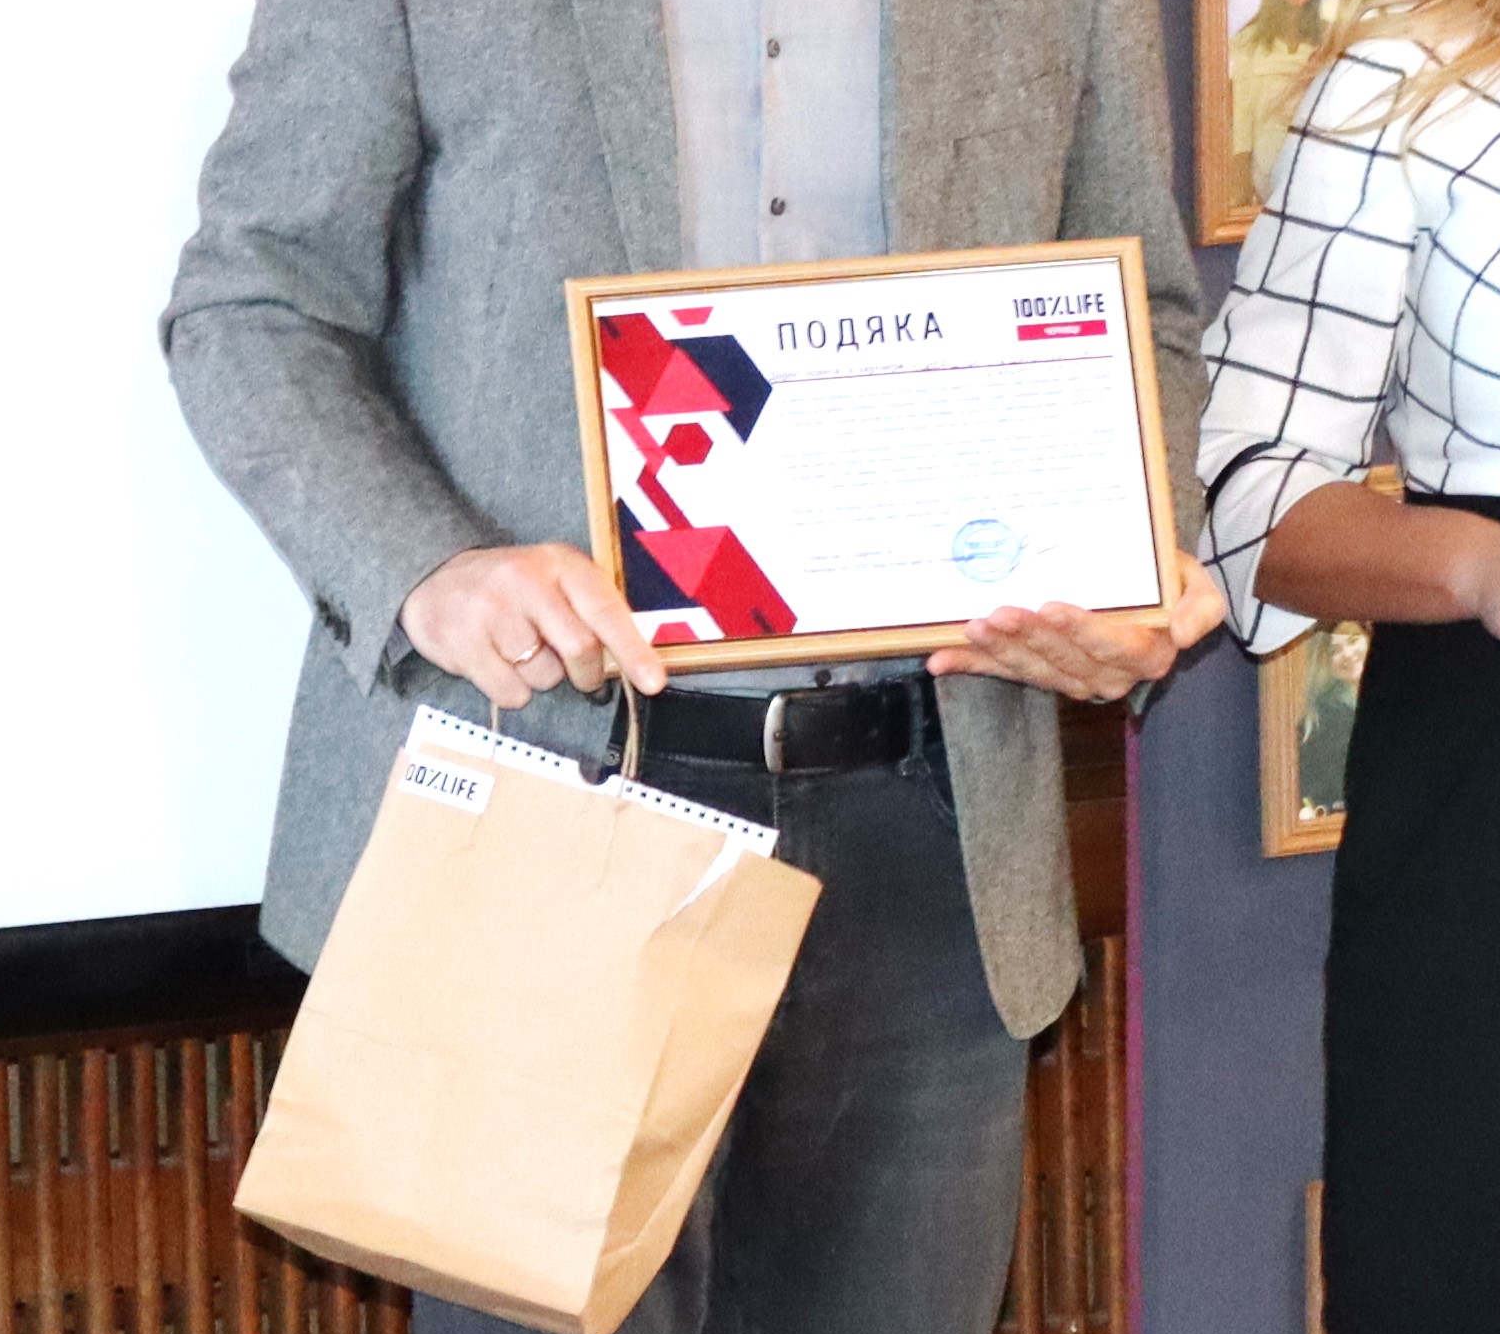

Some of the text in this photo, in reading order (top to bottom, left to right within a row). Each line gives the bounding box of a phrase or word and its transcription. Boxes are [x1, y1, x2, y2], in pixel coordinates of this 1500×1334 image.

[1012, 292, 1106, 320] 100%LIFE
[777, 312, 945, 352] ПОДЯКА
[405, 763, 479, 802] 00%LIFE
